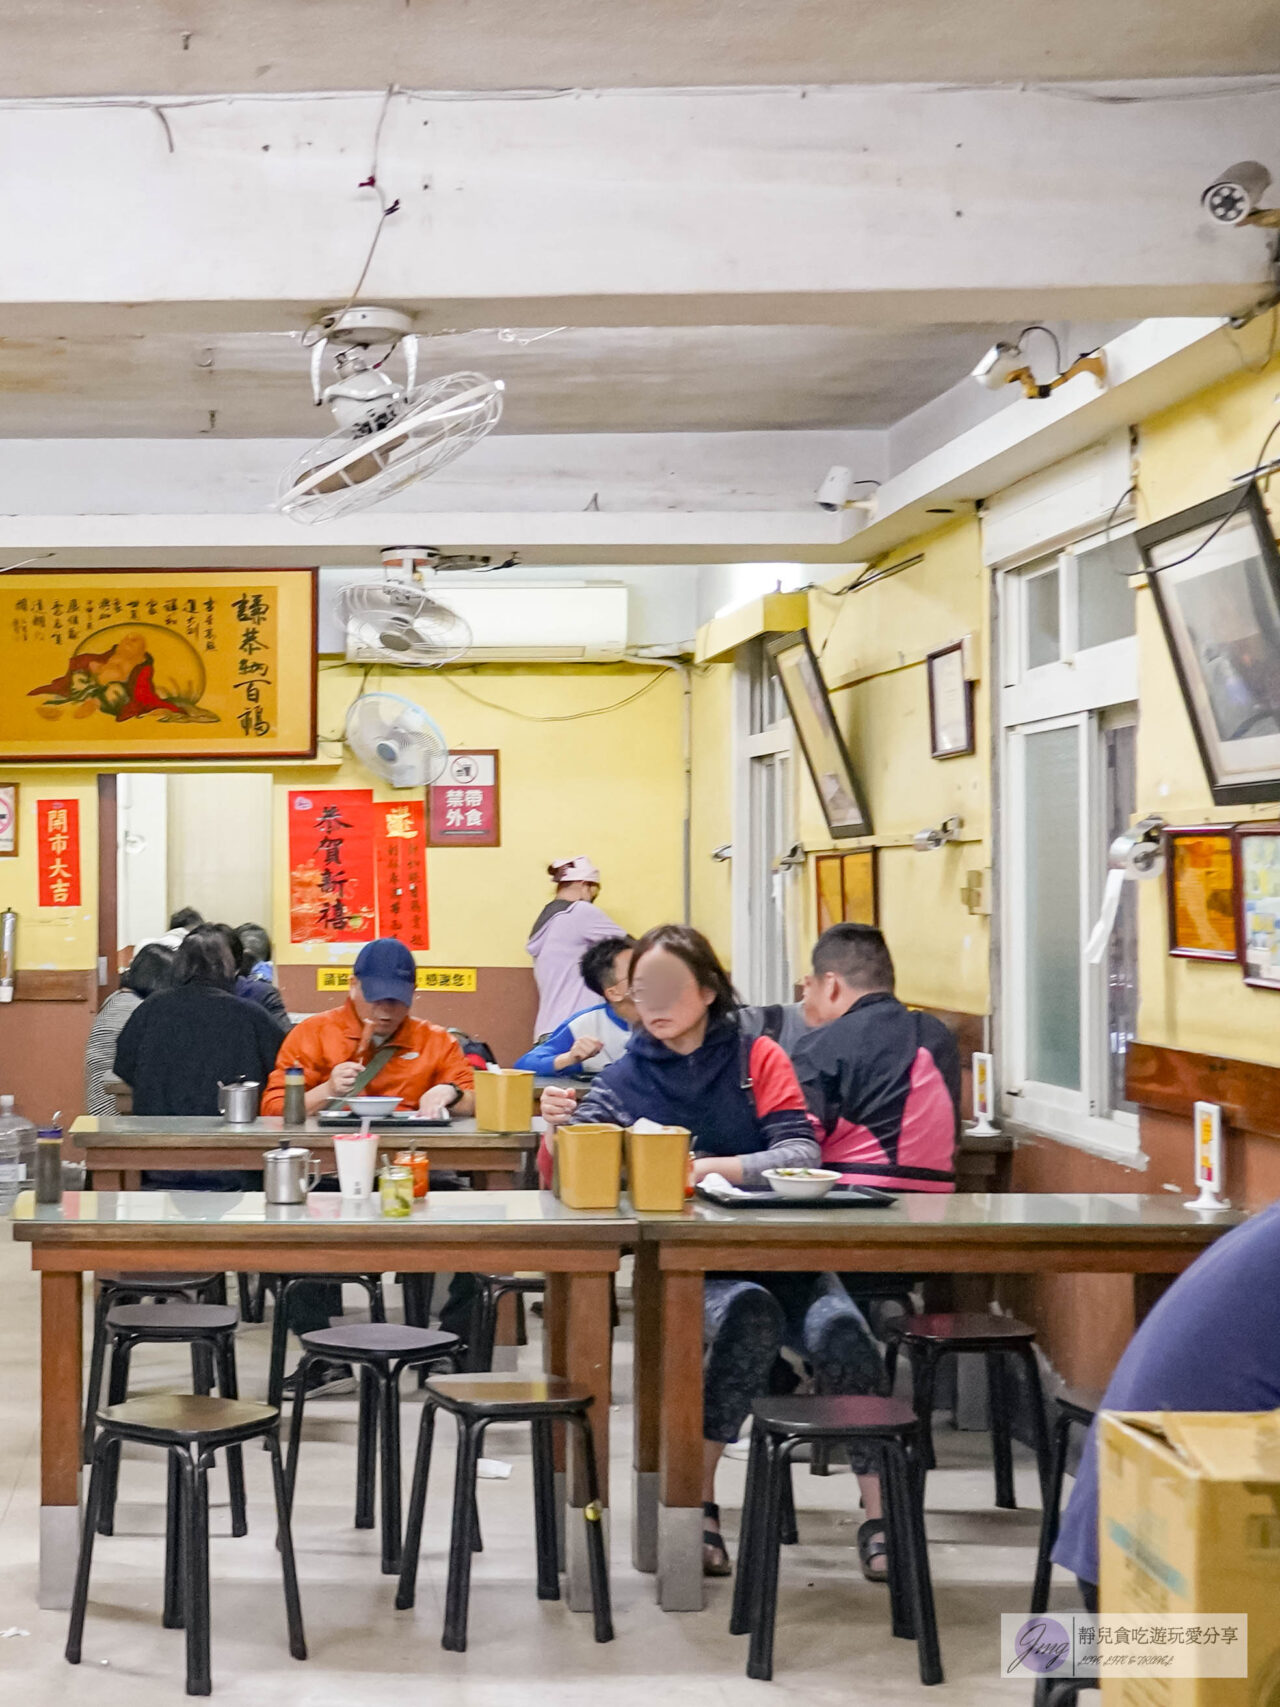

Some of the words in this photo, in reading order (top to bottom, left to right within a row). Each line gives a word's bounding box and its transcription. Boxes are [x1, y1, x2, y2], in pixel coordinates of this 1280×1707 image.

[446, 789, 483, 807] 禁帶
[446, 809, 483, 827] 外食
[48, 809, 72, 903] 開市大吉
[313, 804, 354, 931] 恭賀新禧
